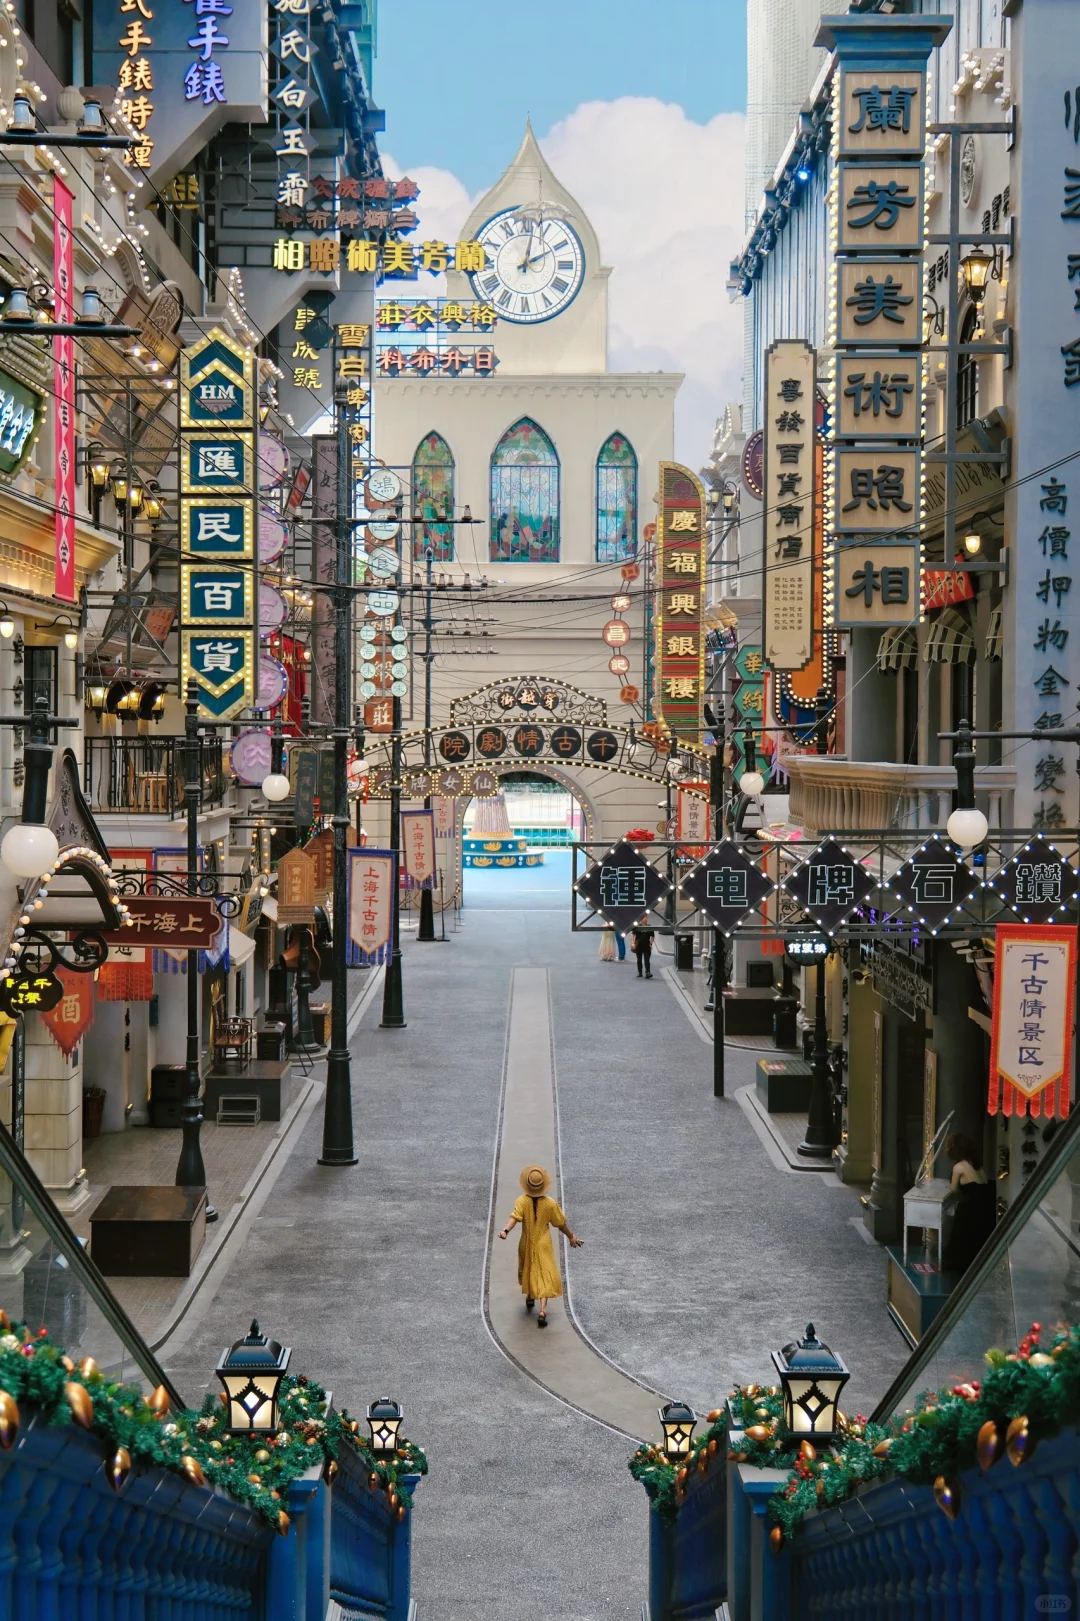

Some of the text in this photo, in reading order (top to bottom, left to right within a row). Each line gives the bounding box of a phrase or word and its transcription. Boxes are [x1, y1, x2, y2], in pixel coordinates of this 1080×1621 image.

[273, 239, 486, 272] 蘭芳美術照相
[200, 385, 236, 400] HM
[842, 85, 918, 607] 蘭芳美術照相
[195, 446, 241, 673] 匯民百貨
[666, 511, 698, 698] 慶福興銀樓
[443, 730, 616, 757] 千古情劇院
[361, 866, 380, 937] 上海千古情
[1018, 952, 1050, 1067] 千古情景区
